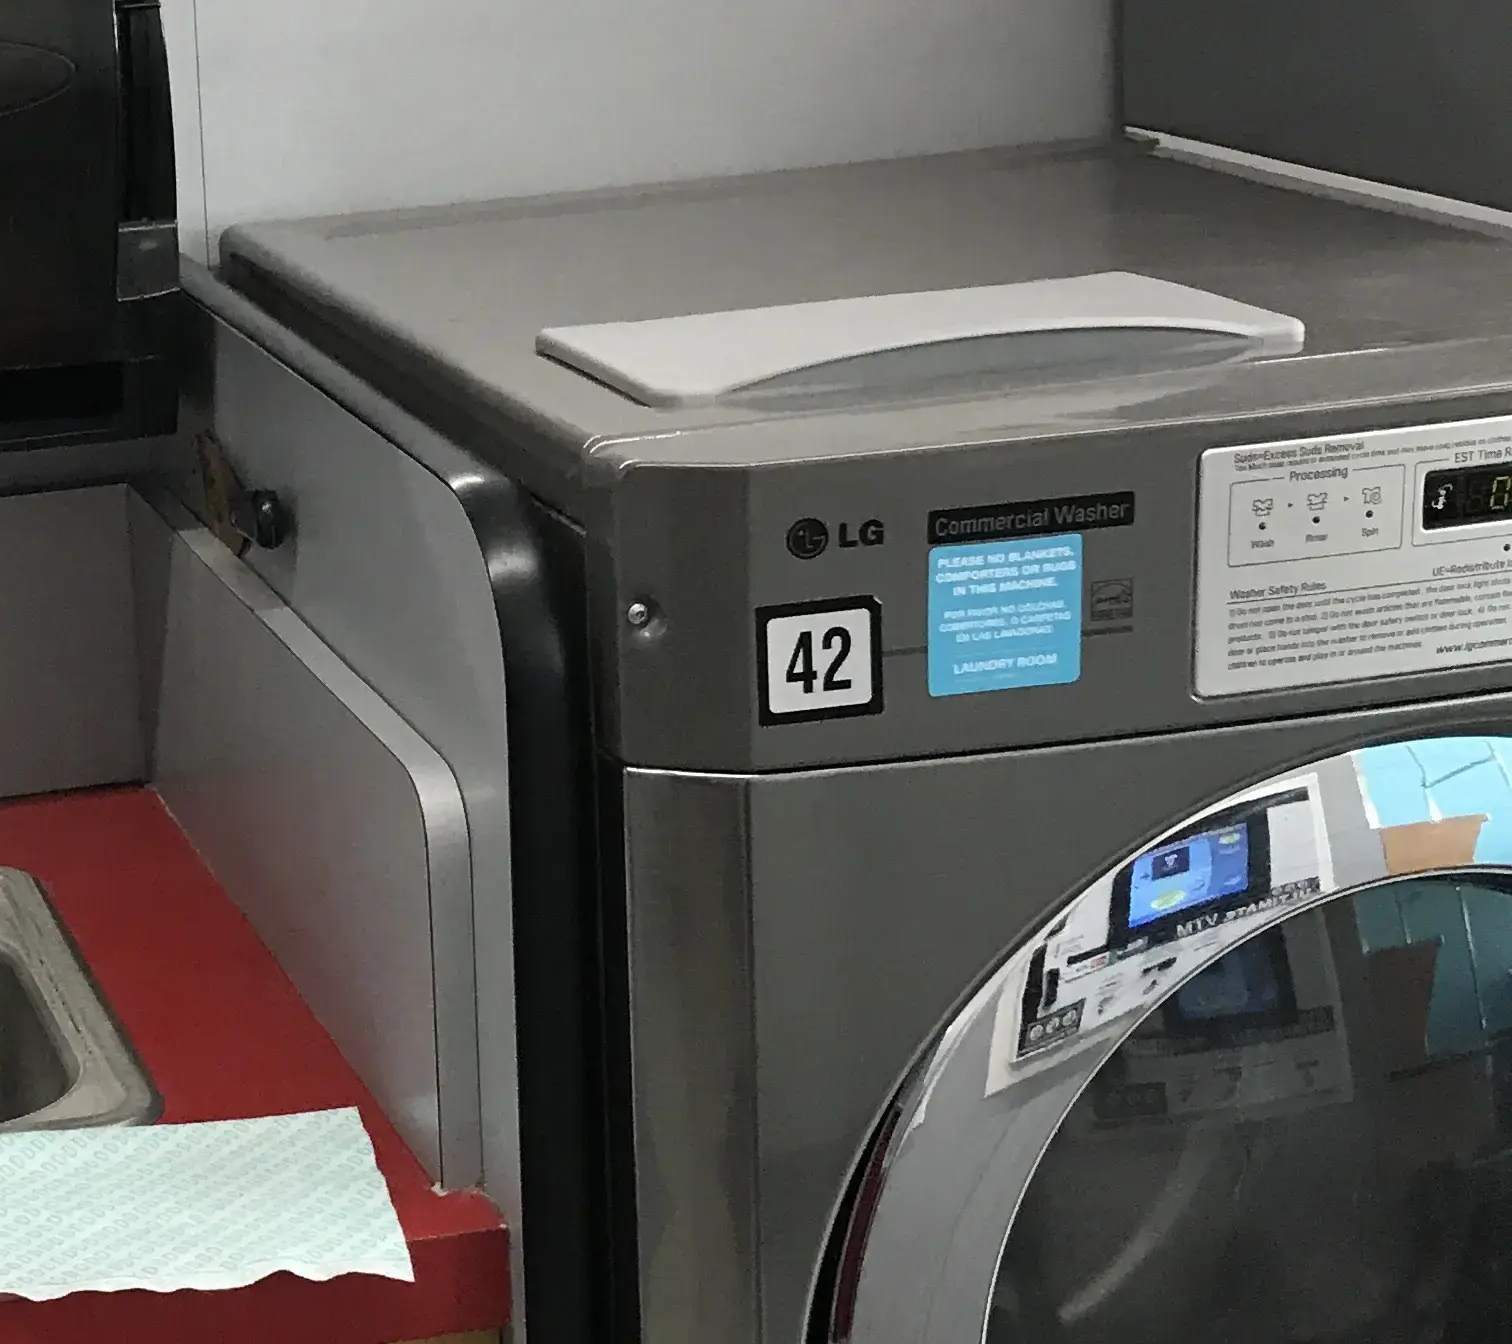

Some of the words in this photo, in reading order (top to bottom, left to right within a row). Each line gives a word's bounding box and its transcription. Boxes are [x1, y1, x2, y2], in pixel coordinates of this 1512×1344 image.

[1454, 450, 1475, 463] EST
[1478, 449, 1502, 460] Time
[1289, 466, 1348, 482] Processing
[936, 508, 1049, 537] Commercial
[1055, 503, 1130, 525] Washer
[839, 519, 884, 548] LG
[938, 555, 984, 568] PLEASE
[987, 553, 1005, 563] NO
[969, 583, 996, 595] THIS
[785, 625, 853, 694] 42
[953, 658, 1013, 675] LAUNDRY
[1017, 653, 1058, 668] ROOM
